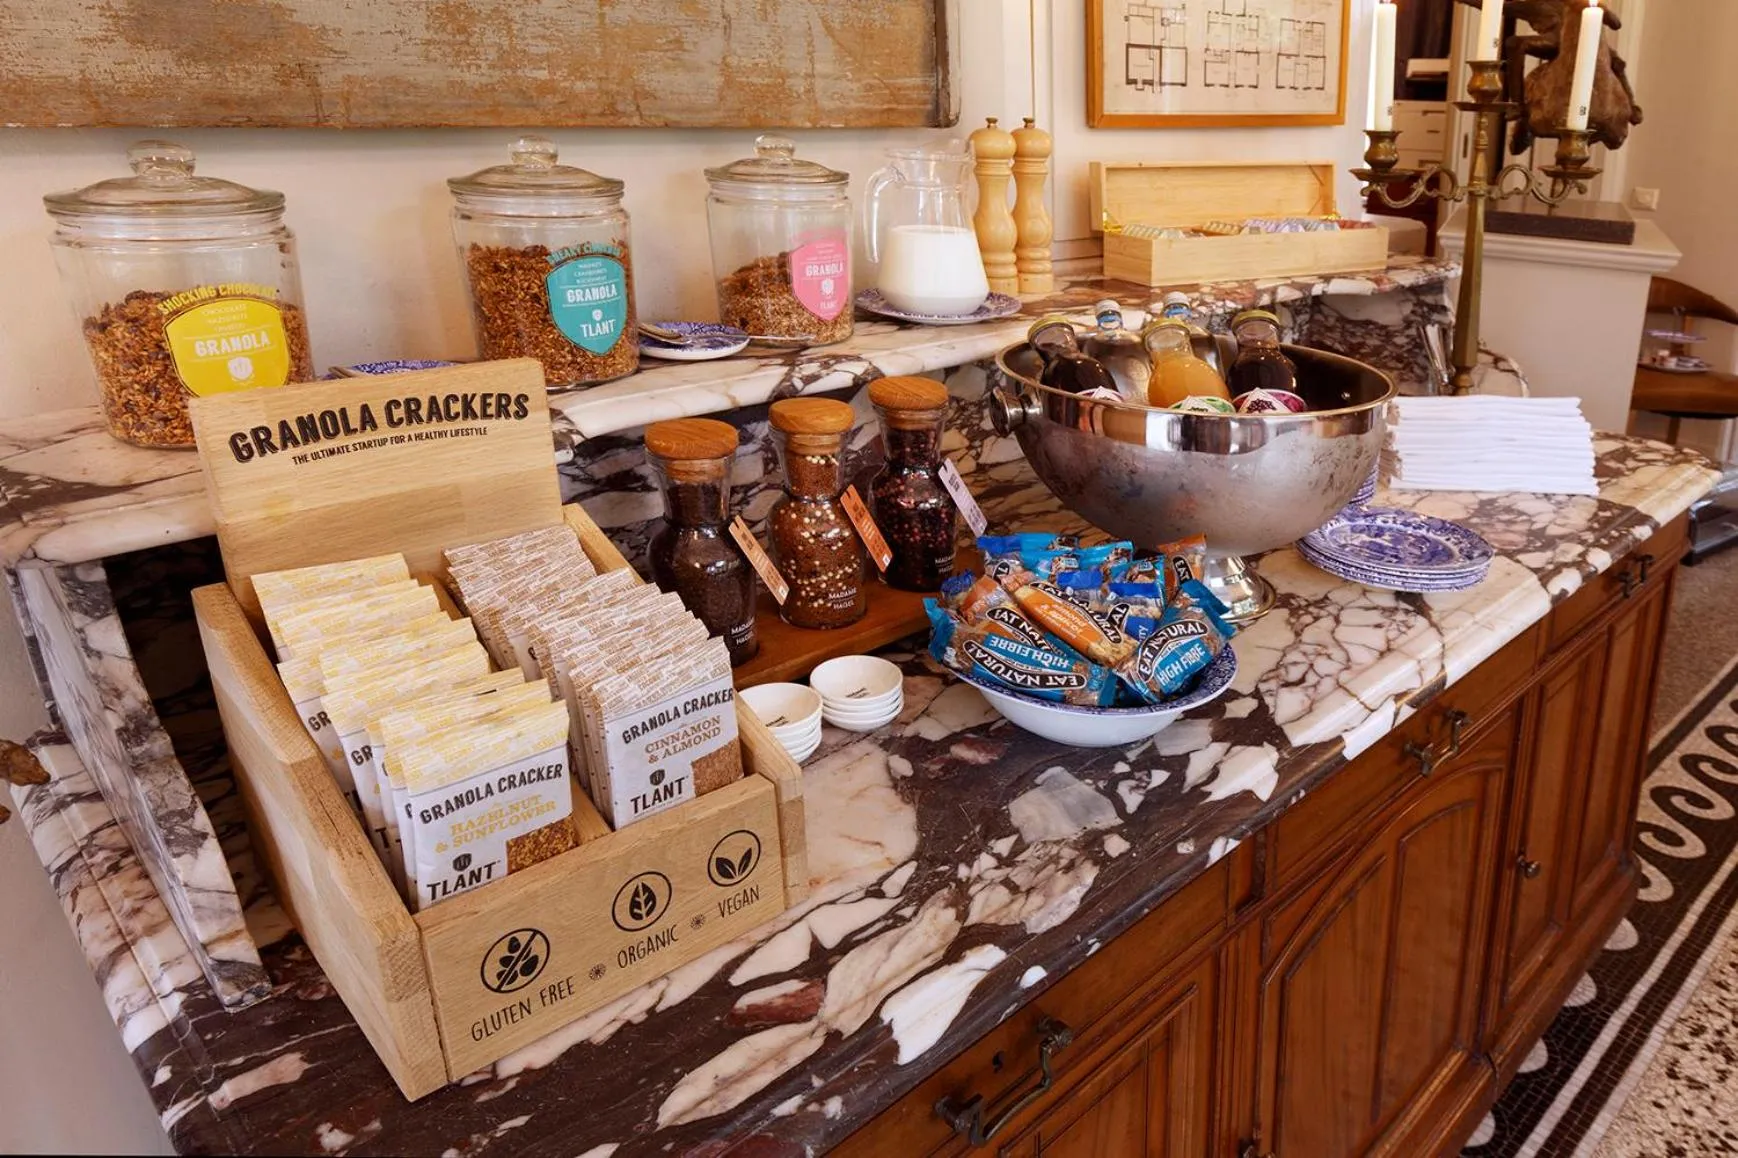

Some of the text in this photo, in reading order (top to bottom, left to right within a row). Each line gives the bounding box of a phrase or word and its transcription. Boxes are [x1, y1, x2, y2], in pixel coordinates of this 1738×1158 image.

[157, 285, 217, 315] SHOCKING
[567, 284, 618, 303] GRANOLA
[195, 332, 271, 357] GRANOLA
[580, 319, 616, 338] TLANT
[228, 393, 530, 463] GRANOLA CRACKERS
[292, 427, 488, 465] THE ULTIMATE STARTUP FOR A HEALTHY LIFESTYLE
[968, 643, 1040, 686] NATURAL
[989, 636, 1031, 657] FIBRE
[1032, 652, 1070, 669] HIGH
[1140, 647, 1156, 676] EAT
[1158, 642, 1206, 686] HIGH FIBRE
[1045, 675, 1078, 686] EAT
[622, 687, 734, 744] GRANOLA CRACKER
[645, 715, 721, 754] CINNAMON
[648, 726, 721, 764] & ALMOND
[420, 783, 494, 824] GRANOLA
[497, 763, 563, 792] CRACKER
[630, 777, 685, 814] TLANT
[434, 801, 557, 853] & SUNFLOWER
[451, 794, 544, 837] HAZELNUT
[426, 861, 497, 900] TLANT
[718, 885, 760, 918] VEGAN
[617, 924, 679, 969] ORGANIC
[471, 975, 576, 1042] GLUTEN FREE
